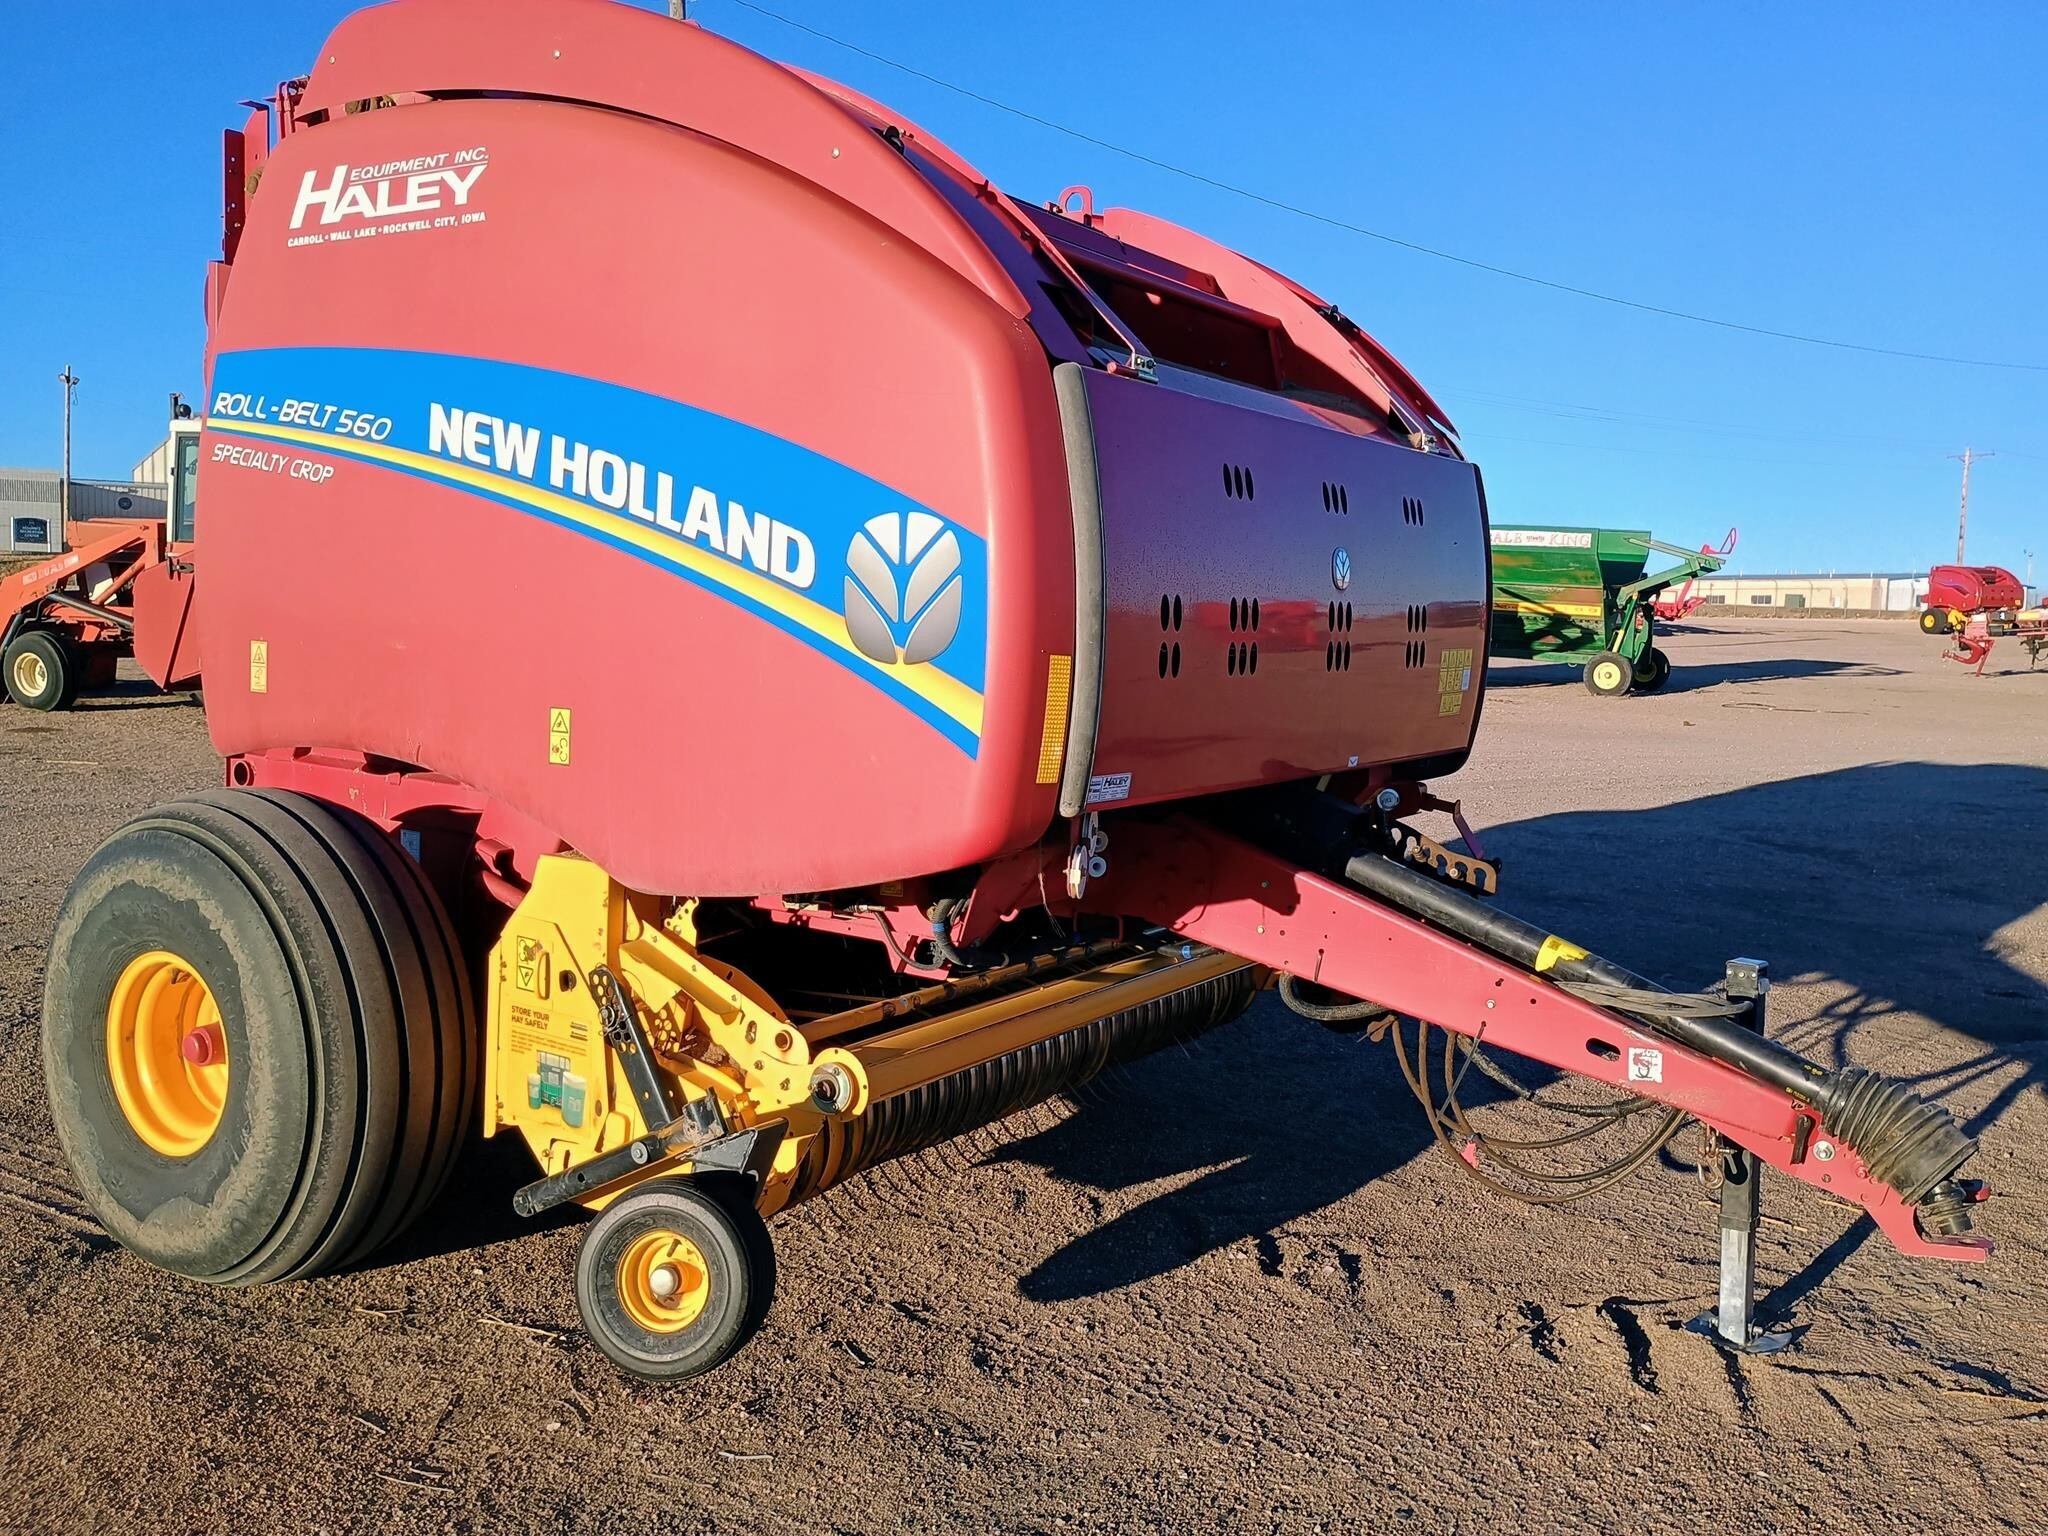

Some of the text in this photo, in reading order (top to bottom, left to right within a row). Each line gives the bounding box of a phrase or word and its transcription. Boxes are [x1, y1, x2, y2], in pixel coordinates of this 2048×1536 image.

[350, 147, 489, 181] EQUIPMENT INC.
[289, 164, 488, 229] HALEY
[287, 211, 486, 247] CARROLL WALL LAKE ROCKWELL CITY, IOWA
[335, 410, 393, 441] 560
[211, 443, 335, 484] SPECIALTY CROP
[428, 402, 816, 589] NEW HOLLAND
[1490, 531, 1522, 544] ALE
[1548, 533, 1590, 547] KING
[511, 1005, 550, 1022] STORE YOUR
[511, 1014, 548, 1030] HAY SAFELY
